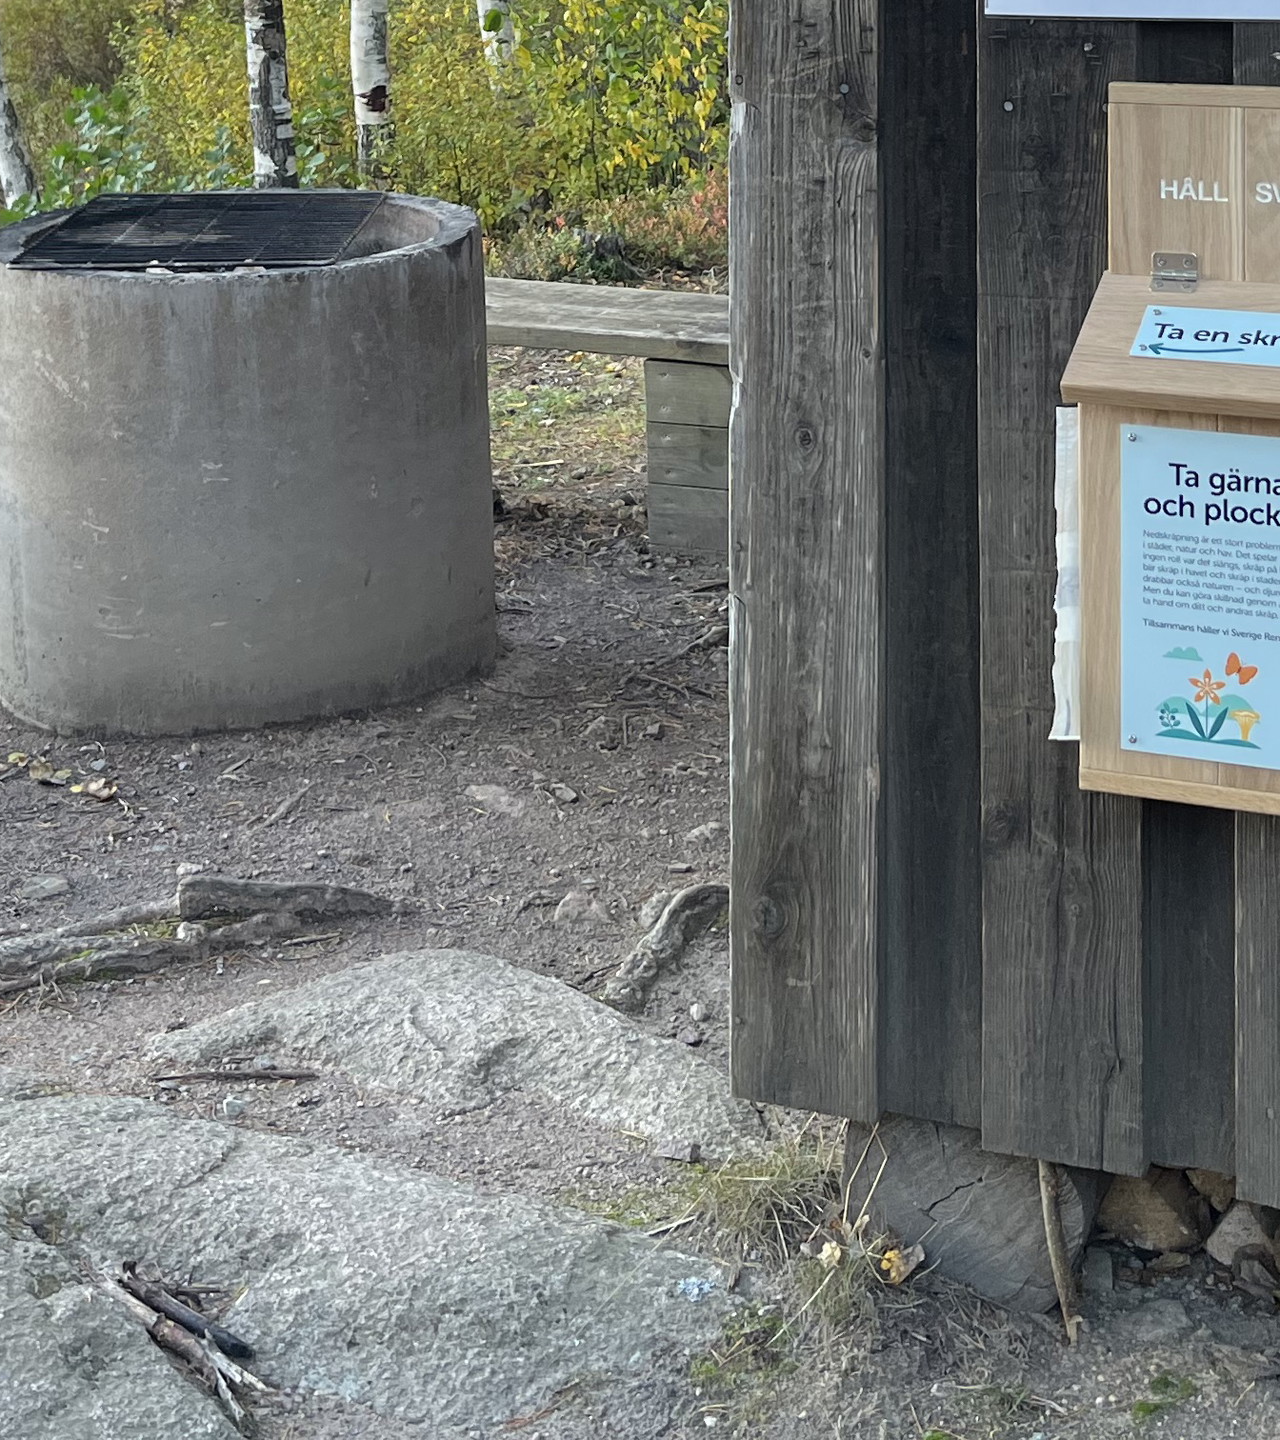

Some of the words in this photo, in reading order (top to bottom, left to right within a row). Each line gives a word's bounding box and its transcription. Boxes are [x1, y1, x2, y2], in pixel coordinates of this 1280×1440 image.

[1160, 177, 1229, 202] HÅLL
[1154, 323, 1184, 341] Ta
[1193, 328, 1230, 344] en
[1168, 462, 1199, 488] Ta
[1144, 494, 1194, 517] och
[1142, 618, 1194, 631] Tillsammans
[1196, 625, 1220, 634] håller
[1231, 628, 1262, 640] Sverige
